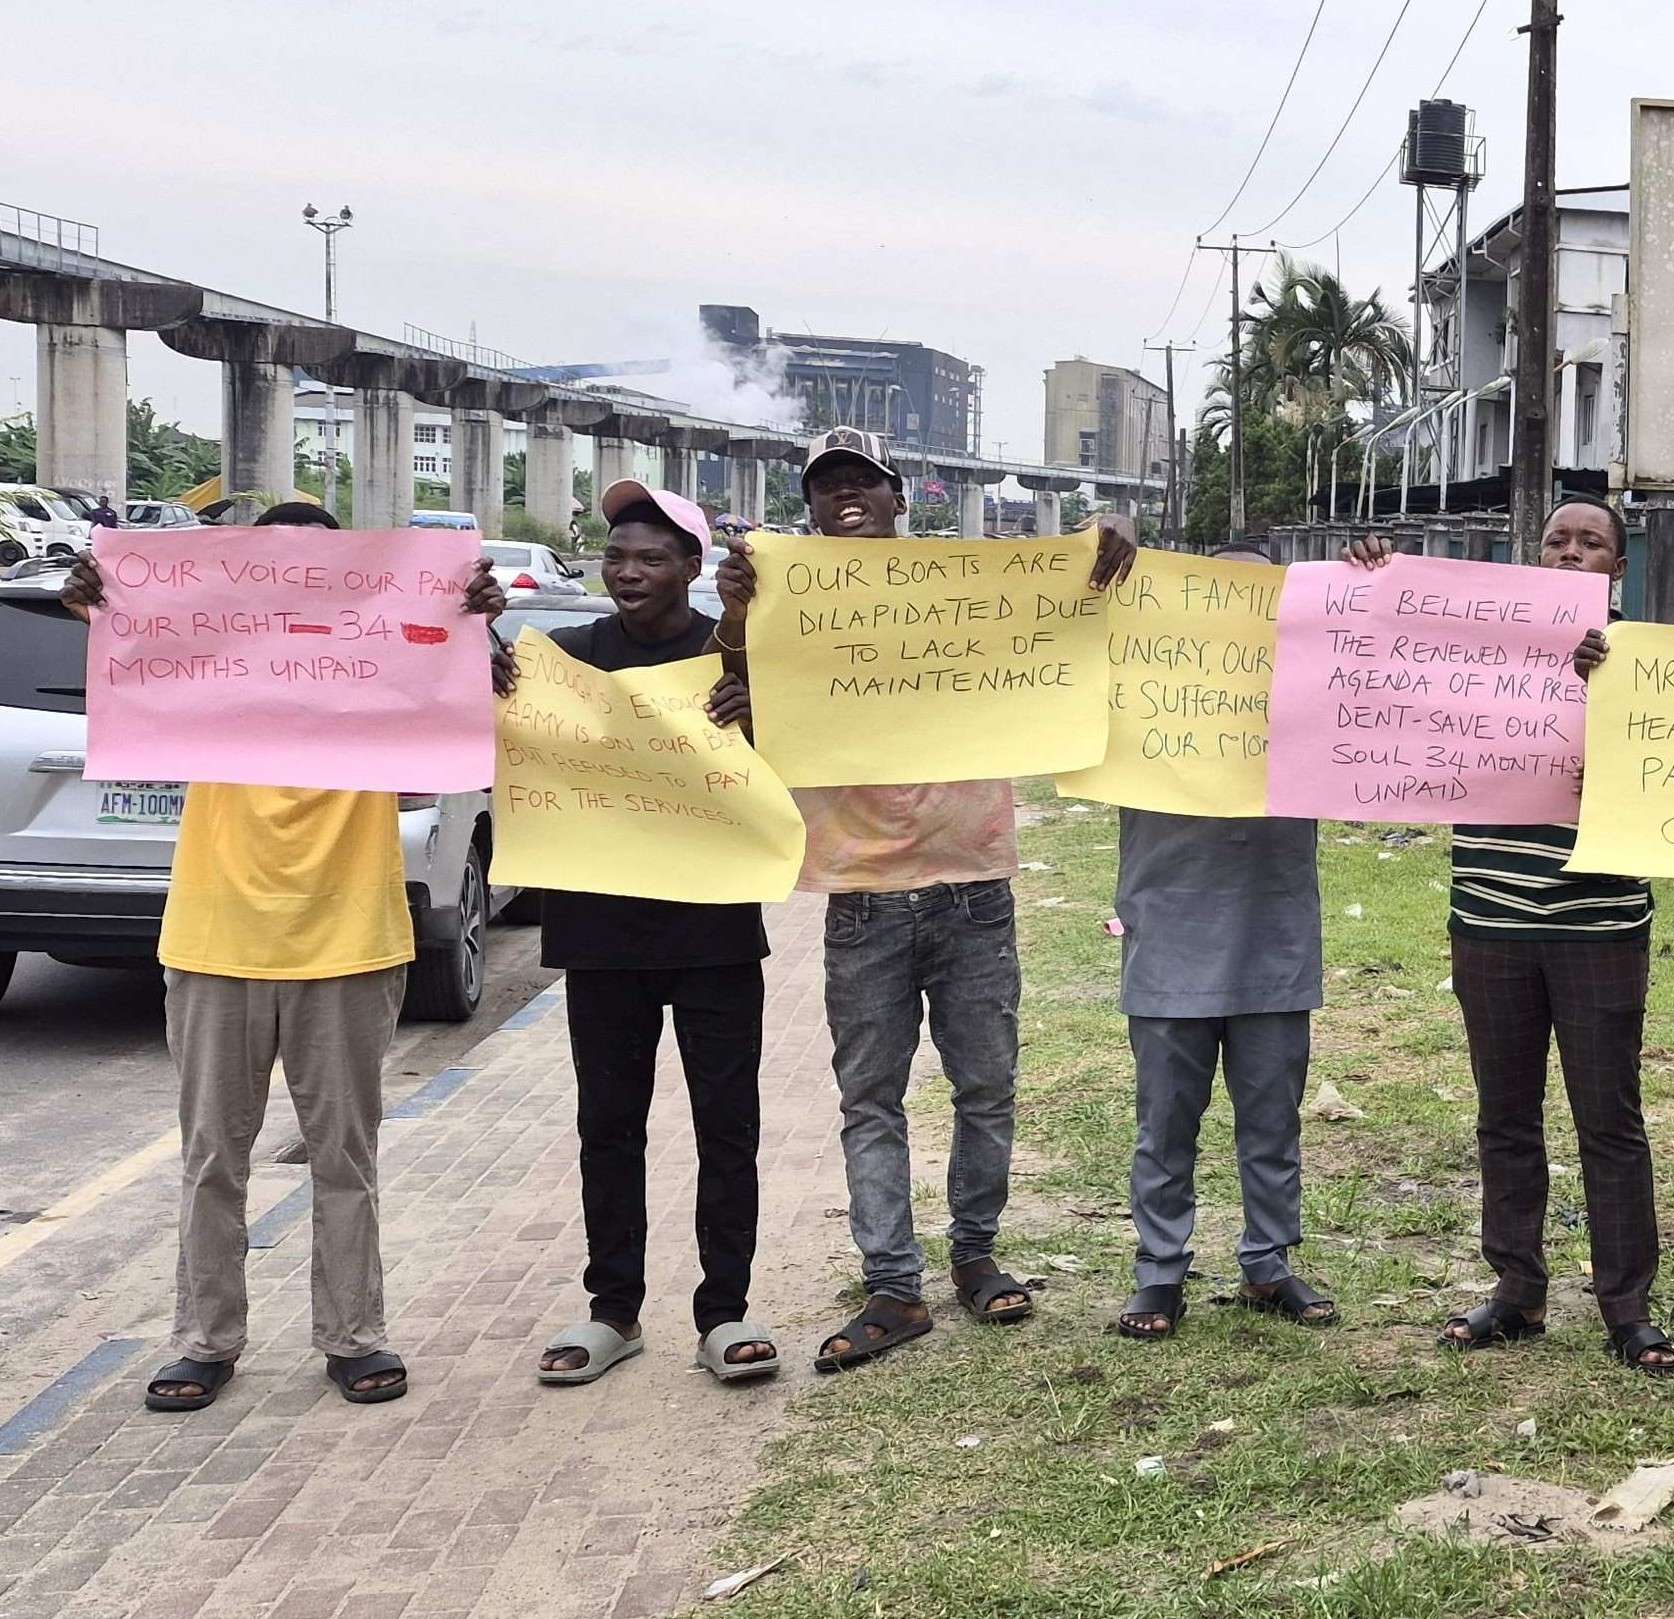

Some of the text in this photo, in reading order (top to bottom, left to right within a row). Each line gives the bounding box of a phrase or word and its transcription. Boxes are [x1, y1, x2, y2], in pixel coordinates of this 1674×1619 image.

[116, 552, 200, 588] OUR
[344, 571, 401, 592] OUR
[419, 570, 468, 595] PAIN
[786, 559, 870, 595] OUR
[1003, 552, 1070, 573] ARE
[799, 593, 1101, 636] DILAPIDATED DUE
[1325, 583, 1580, 625] WE BELIEVE IN
[111, 611, 180, 638] OUR
[339, 611, 392, 641] 34
[834, 632, 1055, 665] TO LACK OF
[1222, 641, 1273, 675] OUR
[1325, 630, 1376, 657] THE
[1390, 636, 1507, 666] RENEWED
[109, 655, 248, 685] MONTHS
[830, 662, 1075, 697] MAINTENANCE
[1328, 667, 1432, 694] AGENDA
[1449, 673, 1486, 694] OF
[1495, 674, 1532, 702] MR
[1140, 680, 1270, 723] SUFFERING
[503, 698, 564, 738] ARMY
[575, 723, 589, 744] IS
[600, 736, 633, 753] ON
[648, 735, 697, 754] OUR
[1142, 728, 1200, 759] OUR
[1505, 713, 1570, 743] OUR
[1331, 743, 1581, 777] SOUL 34 MONTHS
[658, 771, 687, 789] TO
[705, 768, 750, 793] PAY
[1354, 775, 1468, 804] UNPAID
[509, 785, 742, 826] FOR THE SERVICES.
